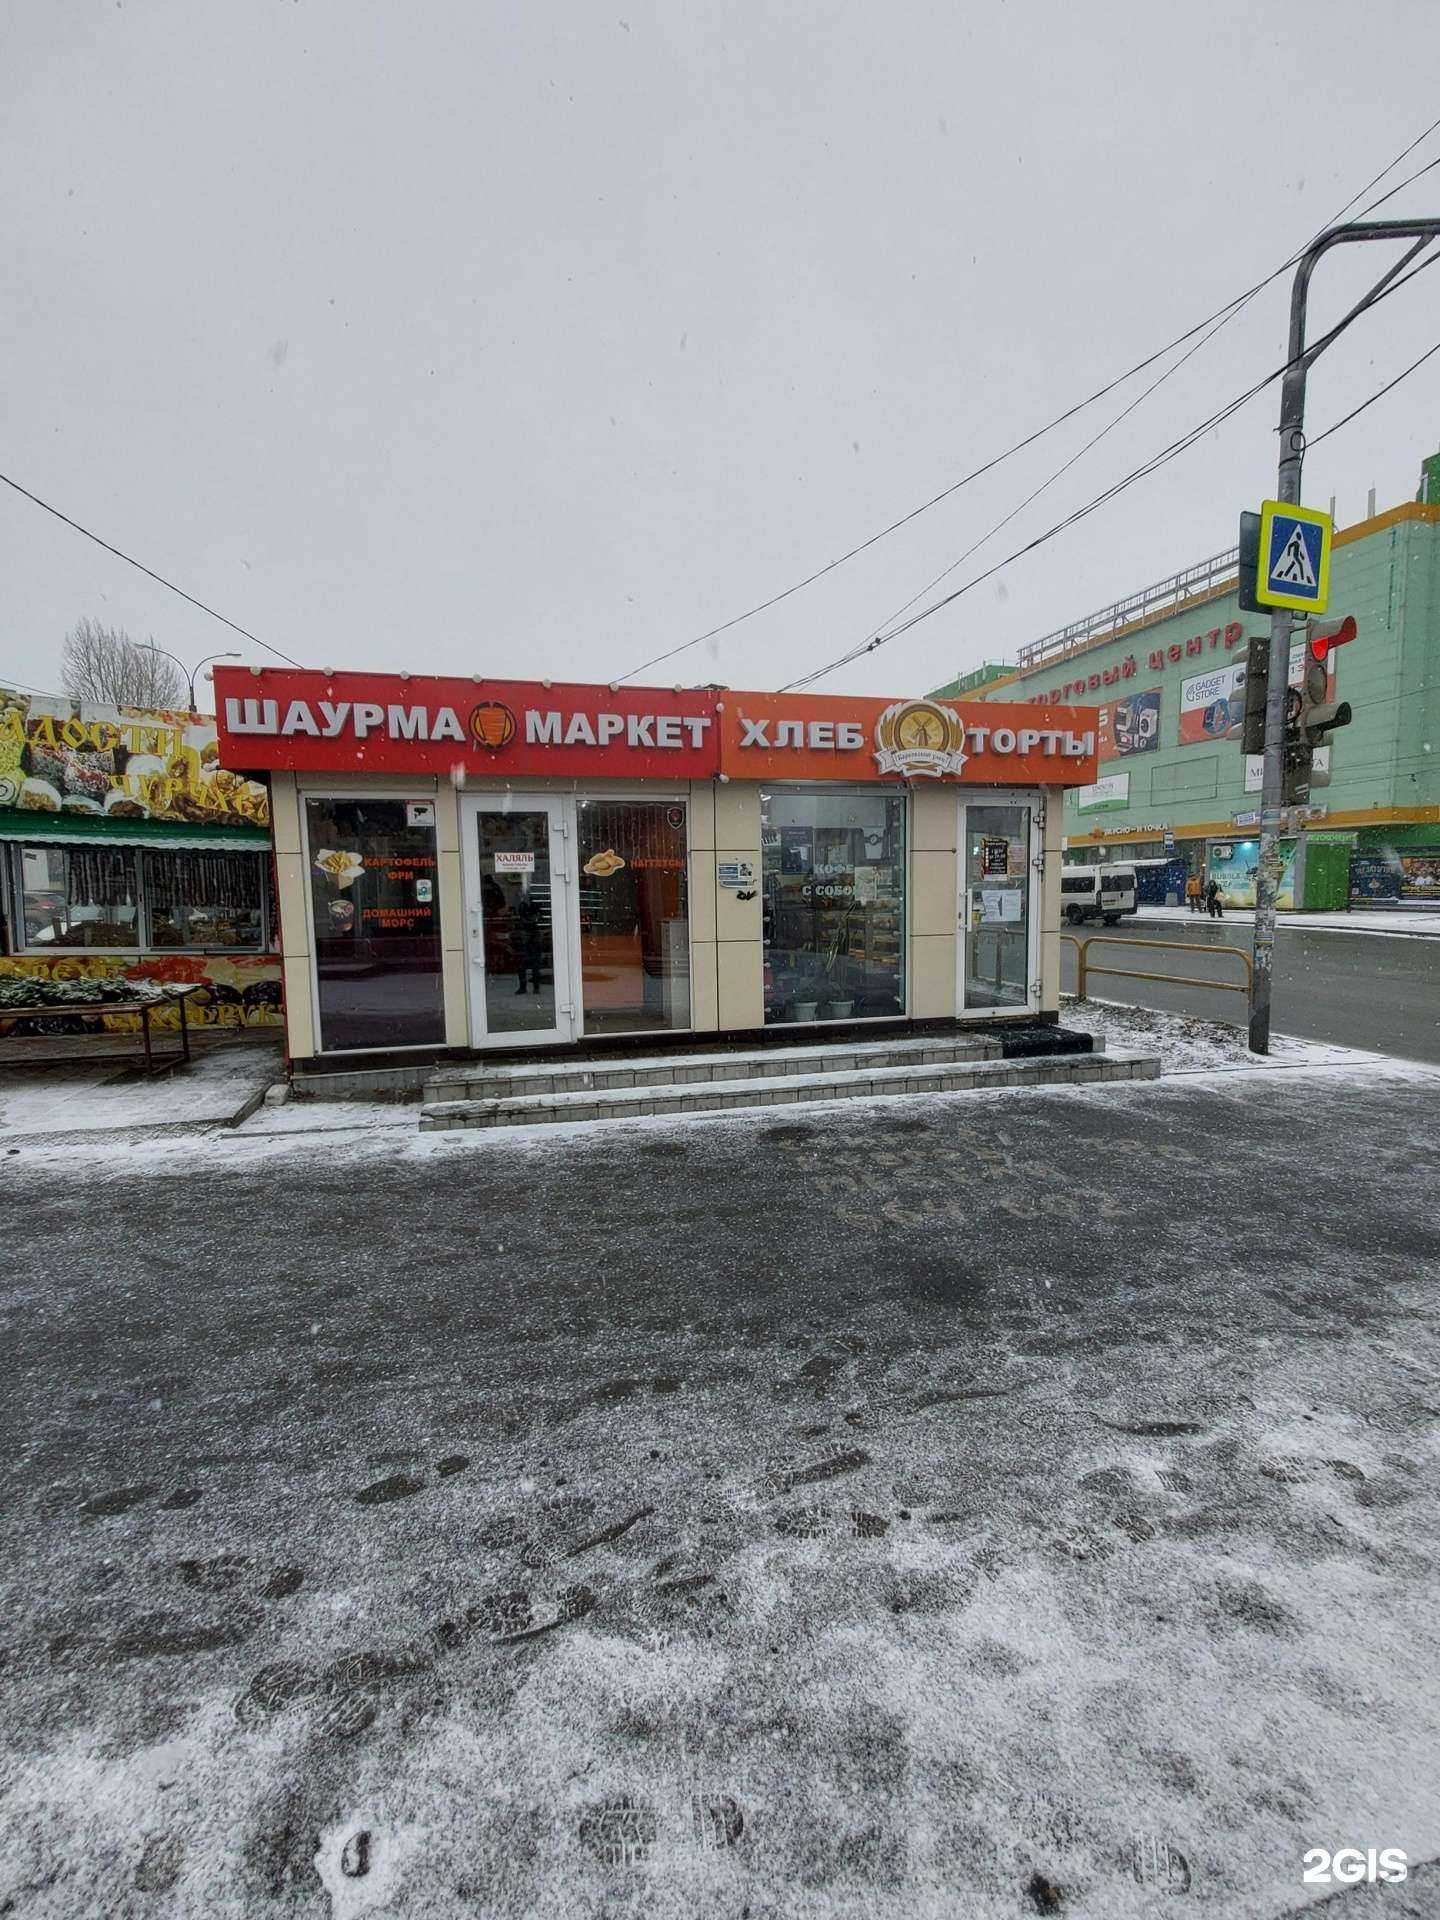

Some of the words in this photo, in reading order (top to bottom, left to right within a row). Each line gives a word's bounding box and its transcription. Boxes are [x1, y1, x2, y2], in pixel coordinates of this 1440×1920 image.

[1026, 656, 1138, 705] орговый
[1149, 622, 1243, 672] центр
[1195, 674, 1226, 691] GADGET
[1195, 686, 1221, 701] STORE
[225, 697, 467, 742] ШАУРМА
[525, 710, 711, 749] МАРКЕТ
[739, 718, 864, 750] ХЛЕБ
[965, 727, 1095, 756] ТОРТЫ
[364, 857, 436, 867] КАРТОФЕЛЬ
[496, 854, 533, 863] ХАЛЯЛЬ
[631, 858, 684, 870] НАГГЕТСЫ
[387, 870, 414, 880] ФРИ
[813, 863, 855, 875] КОФЕ
[802, 885, 812, 896] С
[362, 907, 431, 918] ДОМАШНИЙ
[381, 918, 415, 928] МОРС
